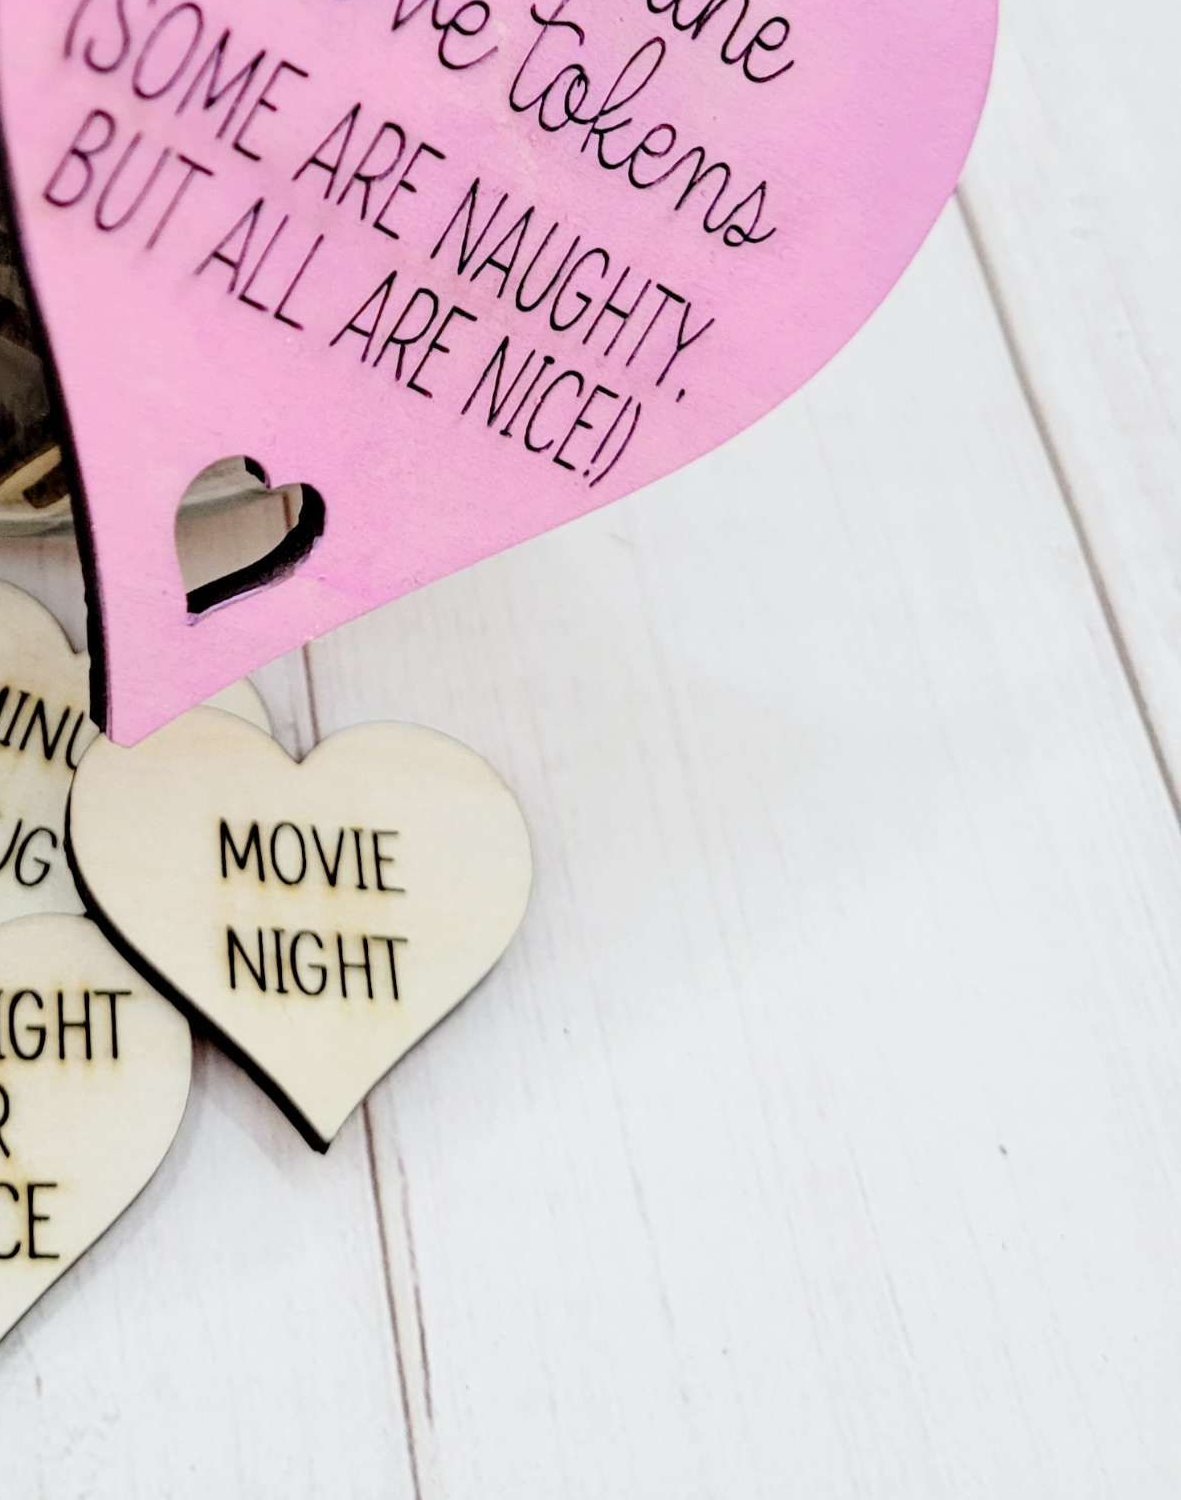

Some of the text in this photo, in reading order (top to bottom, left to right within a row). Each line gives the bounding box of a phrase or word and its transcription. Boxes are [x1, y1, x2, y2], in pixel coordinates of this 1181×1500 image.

[42, 108, 643, 488] BUT ALL ARE NICE!)
[293, 102, 446, 241] ARE
[430, 177, 716, 402] NAUGHTY,
[218, 818, 408, 894] MOVIE
[225, 927, 409, 1003] NIGHT
